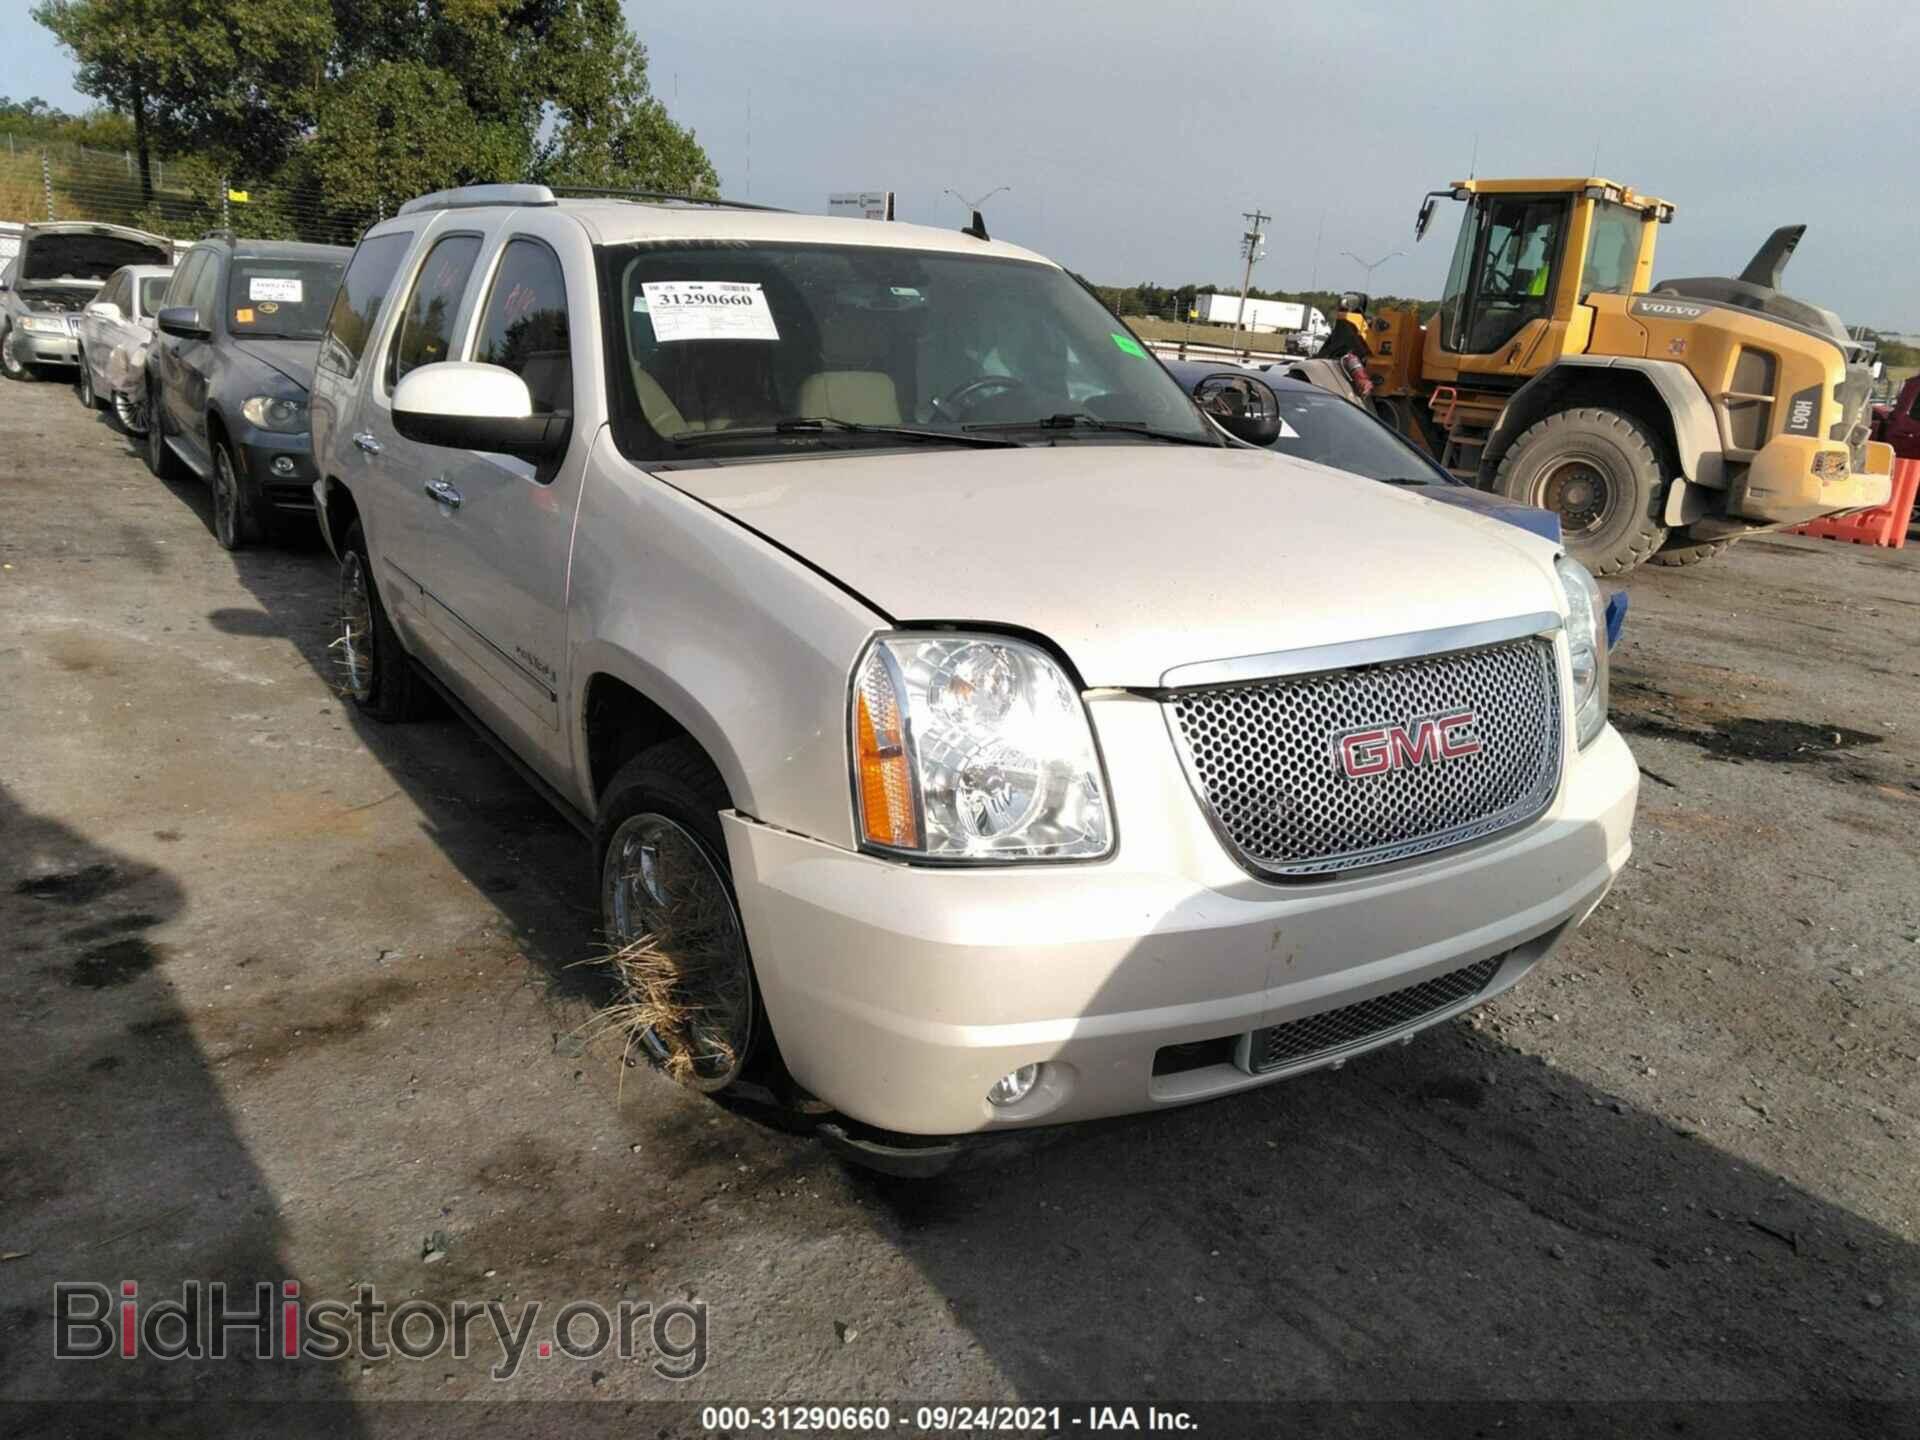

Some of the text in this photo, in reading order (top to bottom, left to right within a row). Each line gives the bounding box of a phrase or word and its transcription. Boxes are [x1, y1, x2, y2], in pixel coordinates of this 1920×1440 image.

[659, 293, 753, 306] 31290660
[1641, 303, 1701, 316] VOLVO
[1790, 400, 1813, 430] L90H
[1340, 712, 1481, 778] GMC
